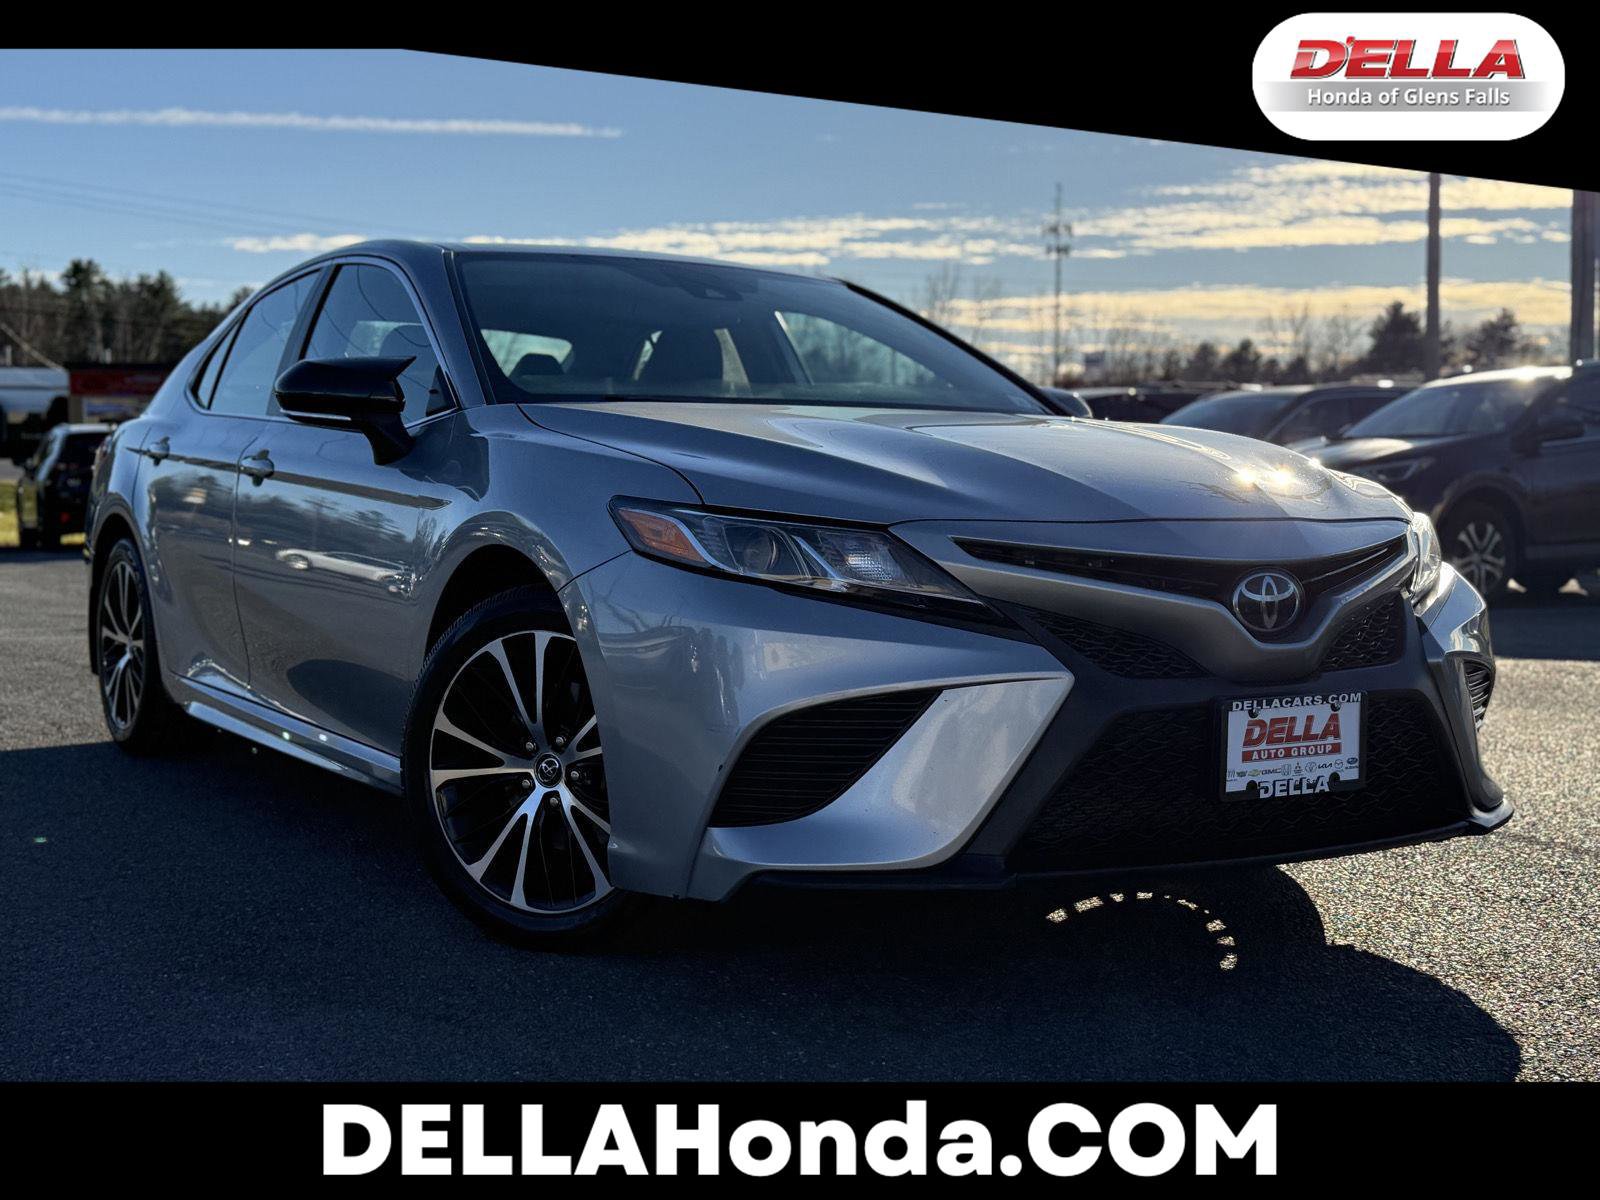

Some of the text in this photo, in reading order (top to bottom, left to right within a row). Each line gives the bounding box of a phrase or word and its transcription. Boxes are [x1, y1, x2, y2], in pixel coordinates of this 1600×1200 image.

[1232, 692, 1362, 711] DELLACARS.COM
[1242, 713, 1342, 747] DELLA
[1251, 744, 1333, 760] AUTO GROUP
[1261, 767, 1282, 775] GMC
[1259, 777, 1330, 798] DELLA
